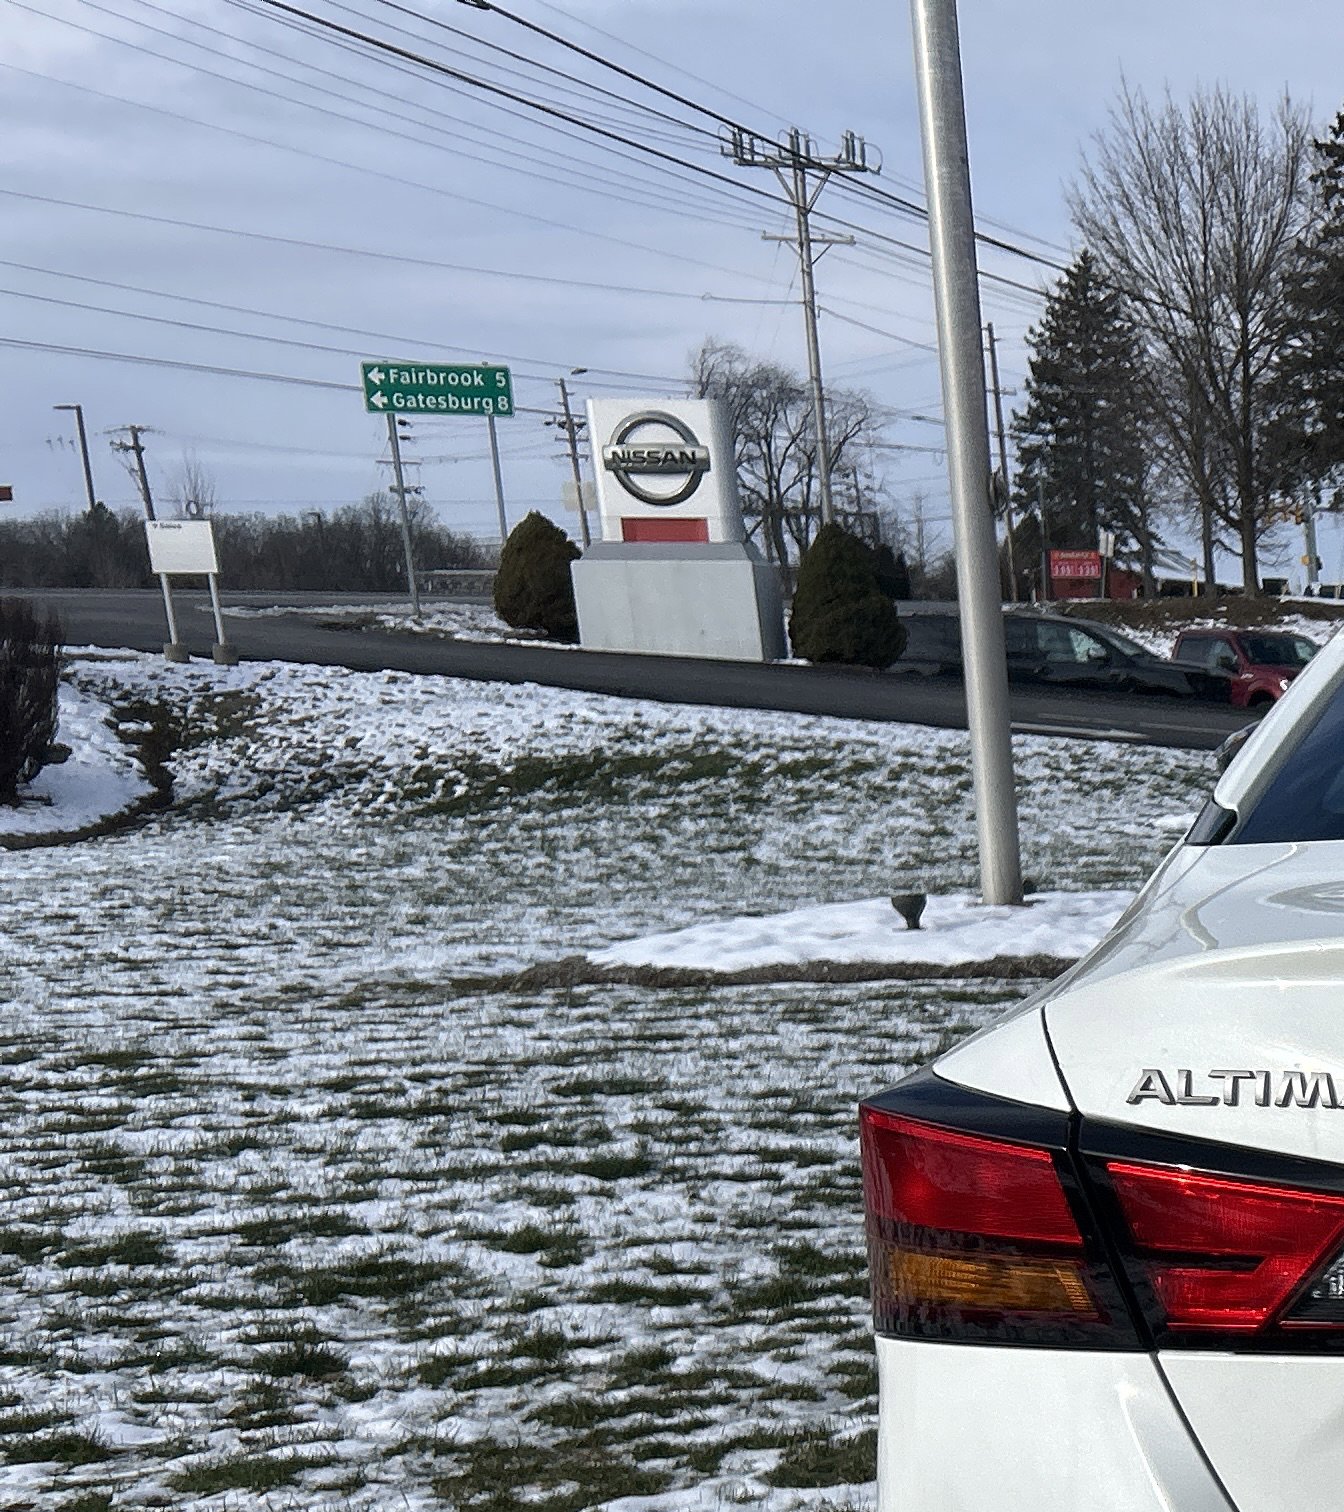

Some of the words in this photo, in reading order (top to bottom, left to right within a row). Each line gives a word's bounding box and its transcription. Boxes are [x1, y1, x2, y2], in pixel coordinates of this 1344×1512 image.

[389, 368, 484, 387] Fairbrook
[495, 371, 506, 388] 5
[392, 392, 493, 414] Gatesburg
[498, 395, 509, 411] 8
[611, 449, 697, 465] NISSAN
